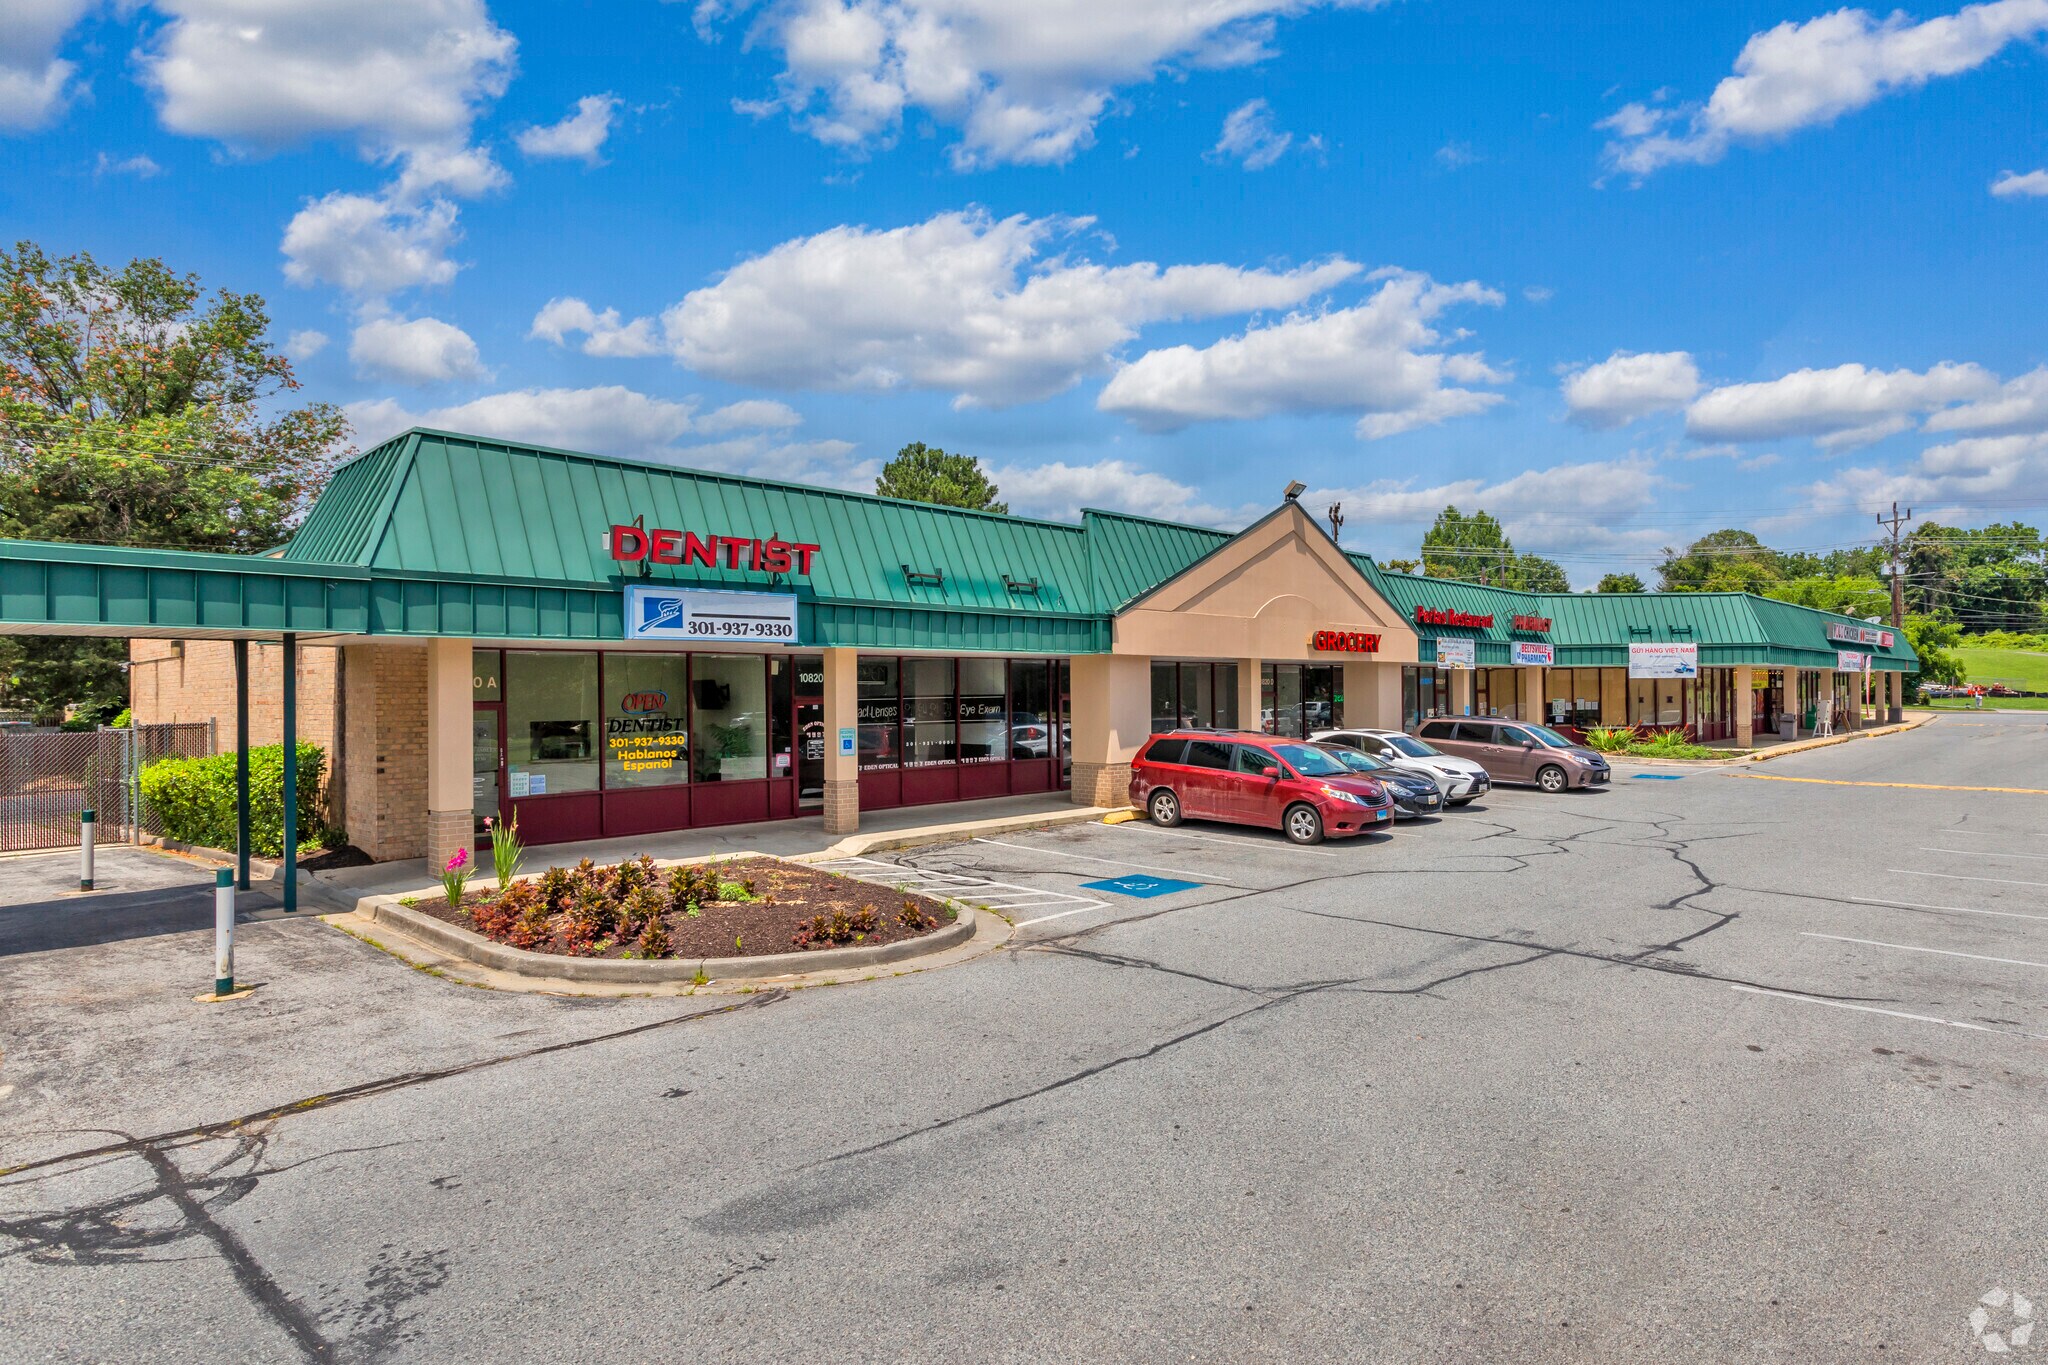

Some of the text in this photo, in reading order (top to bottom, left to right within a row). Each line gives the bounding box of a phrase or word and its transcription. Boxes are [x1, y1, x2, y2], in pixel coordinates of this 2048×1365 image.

[611, 525, 821, 575] DENTIST
[1448, 608, 1494, 628] Restaurant
[1514, 615, 1552, 633] PHARMACY
[688, 621, 793, 637] 301-937-9330
[1315, 630, 1382, 653] GROCERY
[1521, 643, 1547, 653] BELTSVILLE
[1521, 653, 1547, 663] PHARMACY
[487, 676, 497, 688] A
[799, 673, 824, 683] 10820
[623, 693, 665, 711] OPEN
[870, 706, 898, 718] Lenses
[960, 703, 976, 716] Eye
[978, 704, 1001, 715] Exam
[608, 718, 684, 733] DENTIST
[609, 735, 685, 748] 301-937-9330
[618, 749, 677, 760] Hablanos
